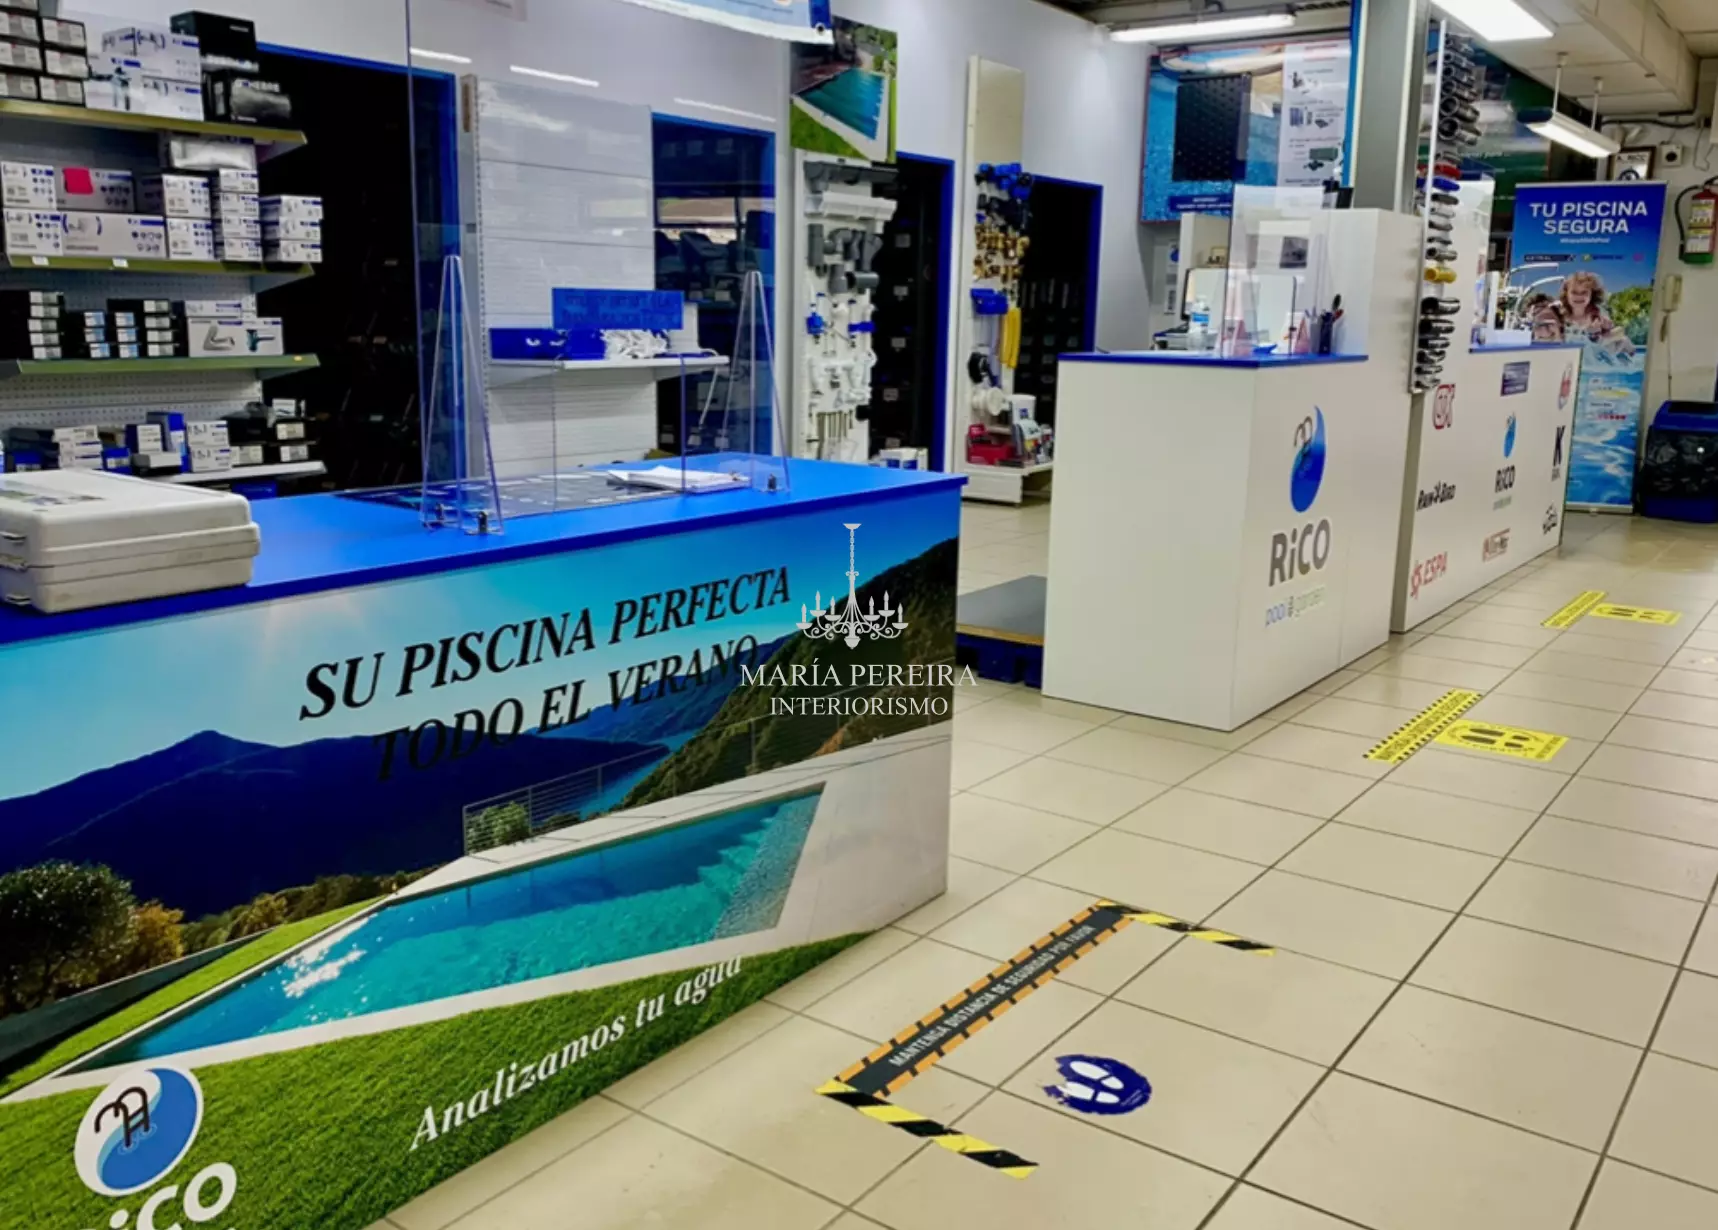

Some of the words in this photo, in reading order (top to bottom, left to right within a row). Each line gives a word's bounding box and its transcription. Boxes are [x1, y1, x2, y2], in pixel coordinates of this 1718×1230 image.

[1529, 202, 1557, 218] TU
[1562, 200, 1648, 217] PISCINA
[1543, 219, 1630, 235] SEGURA
[1424, 551, 1448, 586] ESPA
[298, 652, 384, 721] SU
[396, 608, 594, 696] PISCINA
[608, 566, 790, 645] PERFECTA
[374, 697, 524, 782] TODO
[539, 677, 592, 732] EL
[607, 633, 759, 712] VERANO
[409, 1013, 625, 1153] Analizamos
[636, 995, 666, 1031] tu
[674, 955, 741, 1006] agua
[888, 1021, 952, 1067] MANTENGA
[944, 991, 998, 1029] DISTANCIA
[991, 981, 1011, 996] DE
[1004, 951, 1056, 987] SEGURIDAD
[1049, 940, 1068, 957] POR
[1066, 924, 1097, 943] FAVOR
